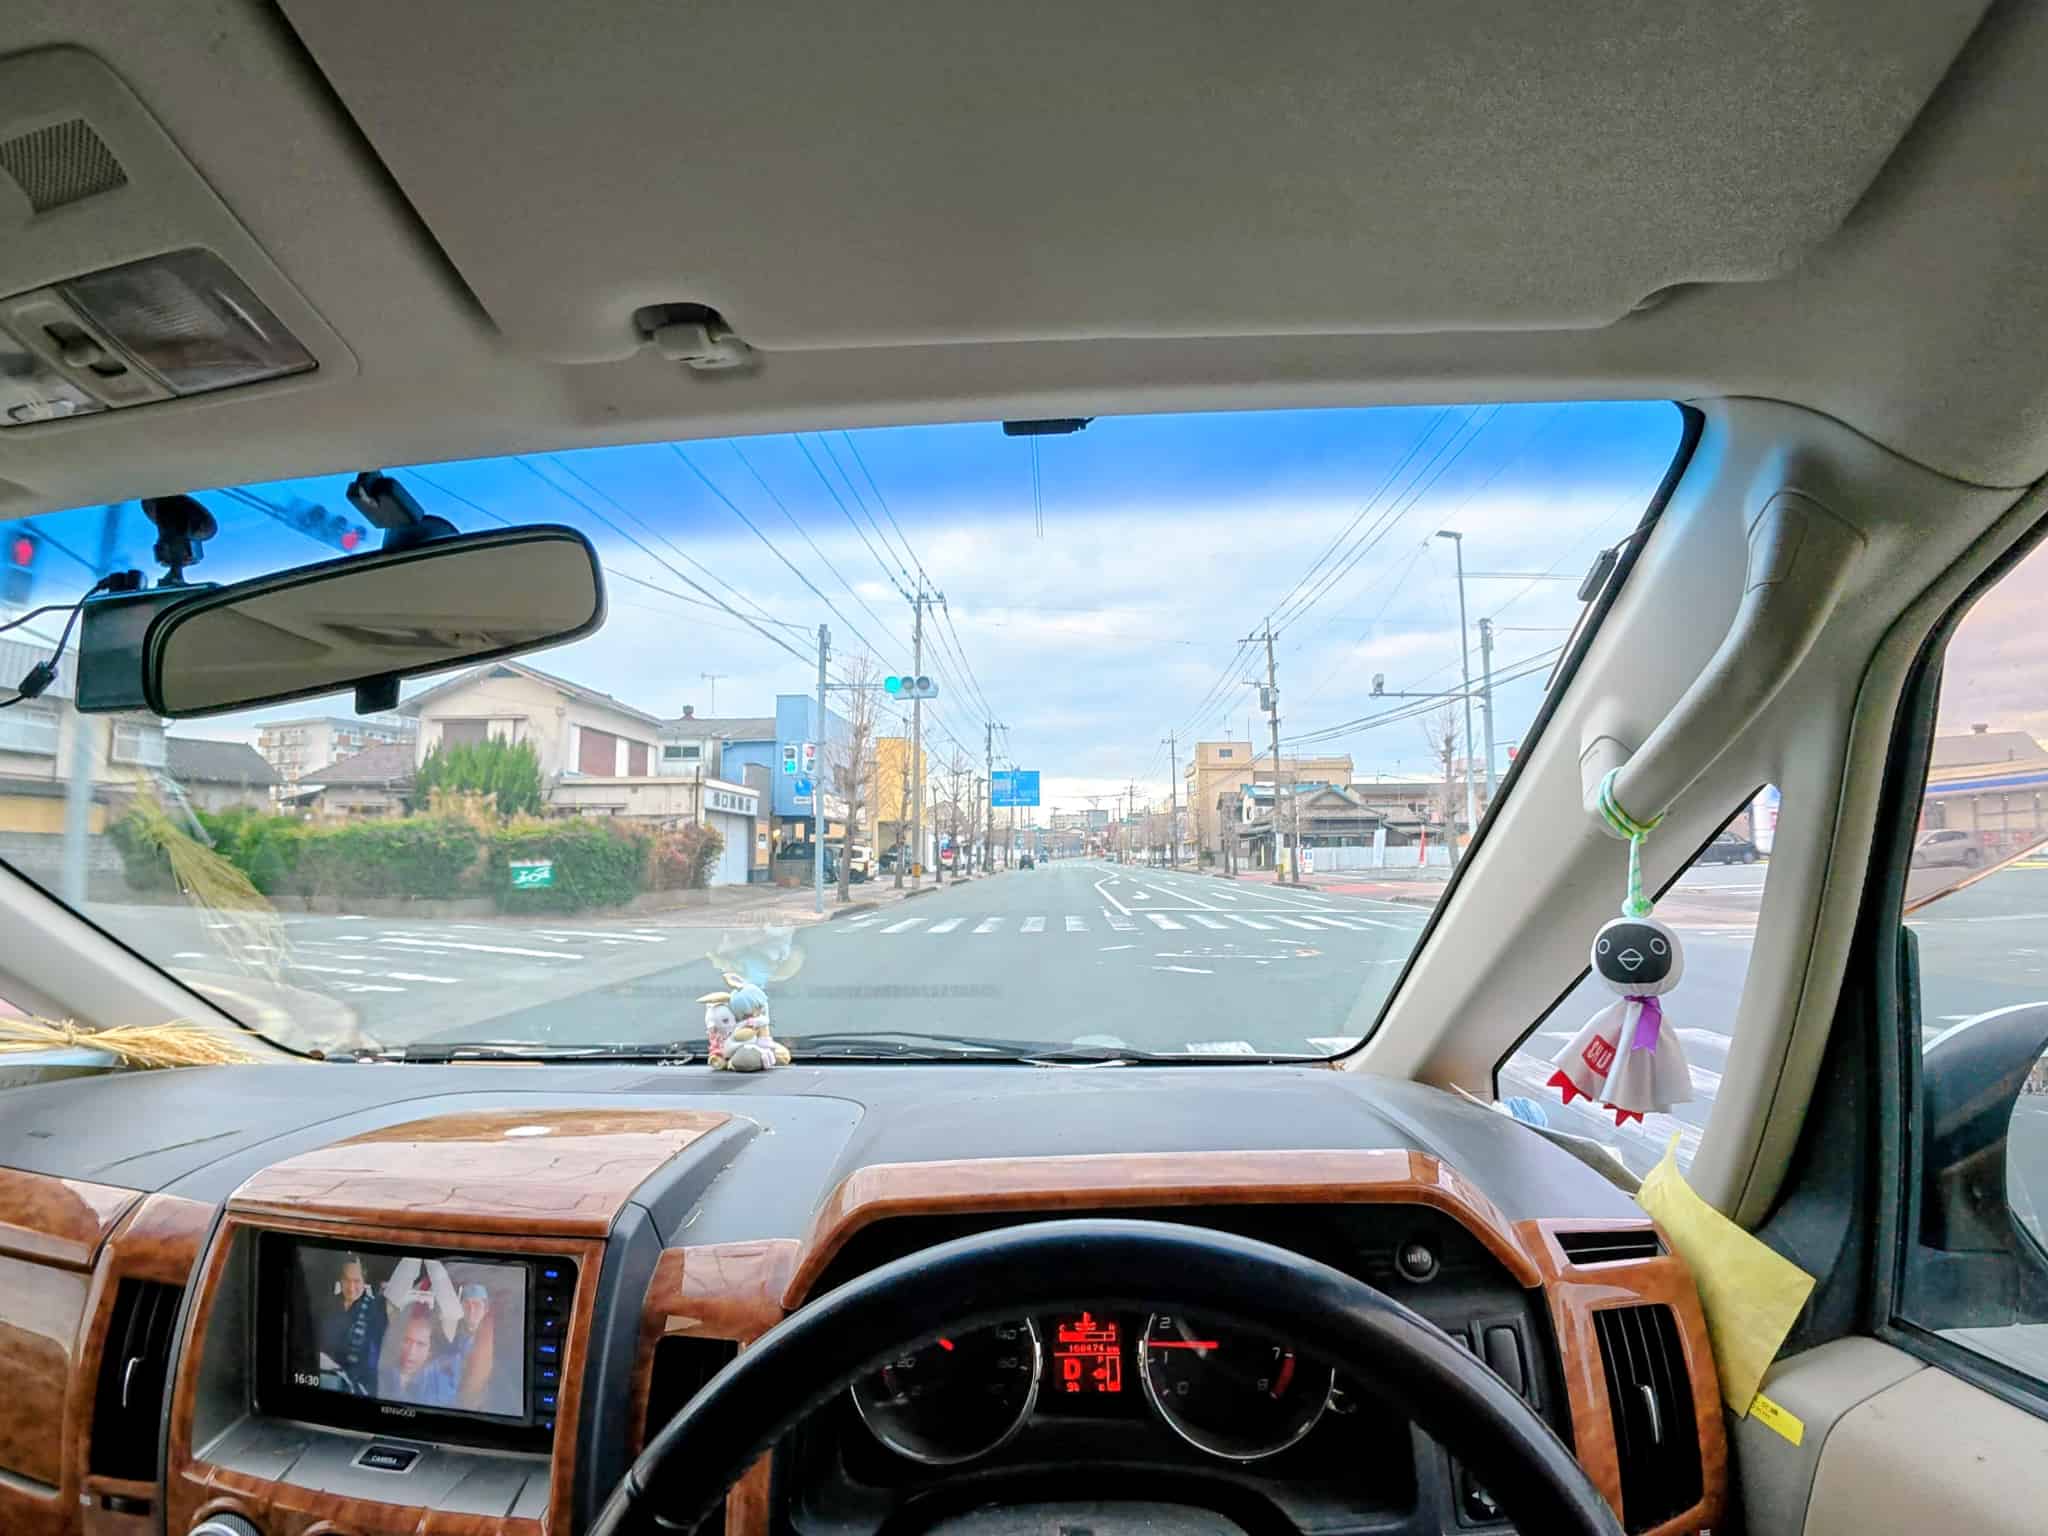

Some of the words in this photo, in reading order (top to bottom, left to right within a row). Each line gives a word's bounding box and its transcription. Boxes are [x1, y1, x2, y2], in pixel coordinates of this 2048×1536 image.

[1407, 1253, 1431, 1264] INFO
[1159, 1316, 1171, 1329] 2
[1271, 1346, 1281, 1360] 7
[1064, 1359, 1082, 1380] D
[293, 1372, 320, 1387] 16:30
[380, 1405, 416, 1418] KENWOOD
